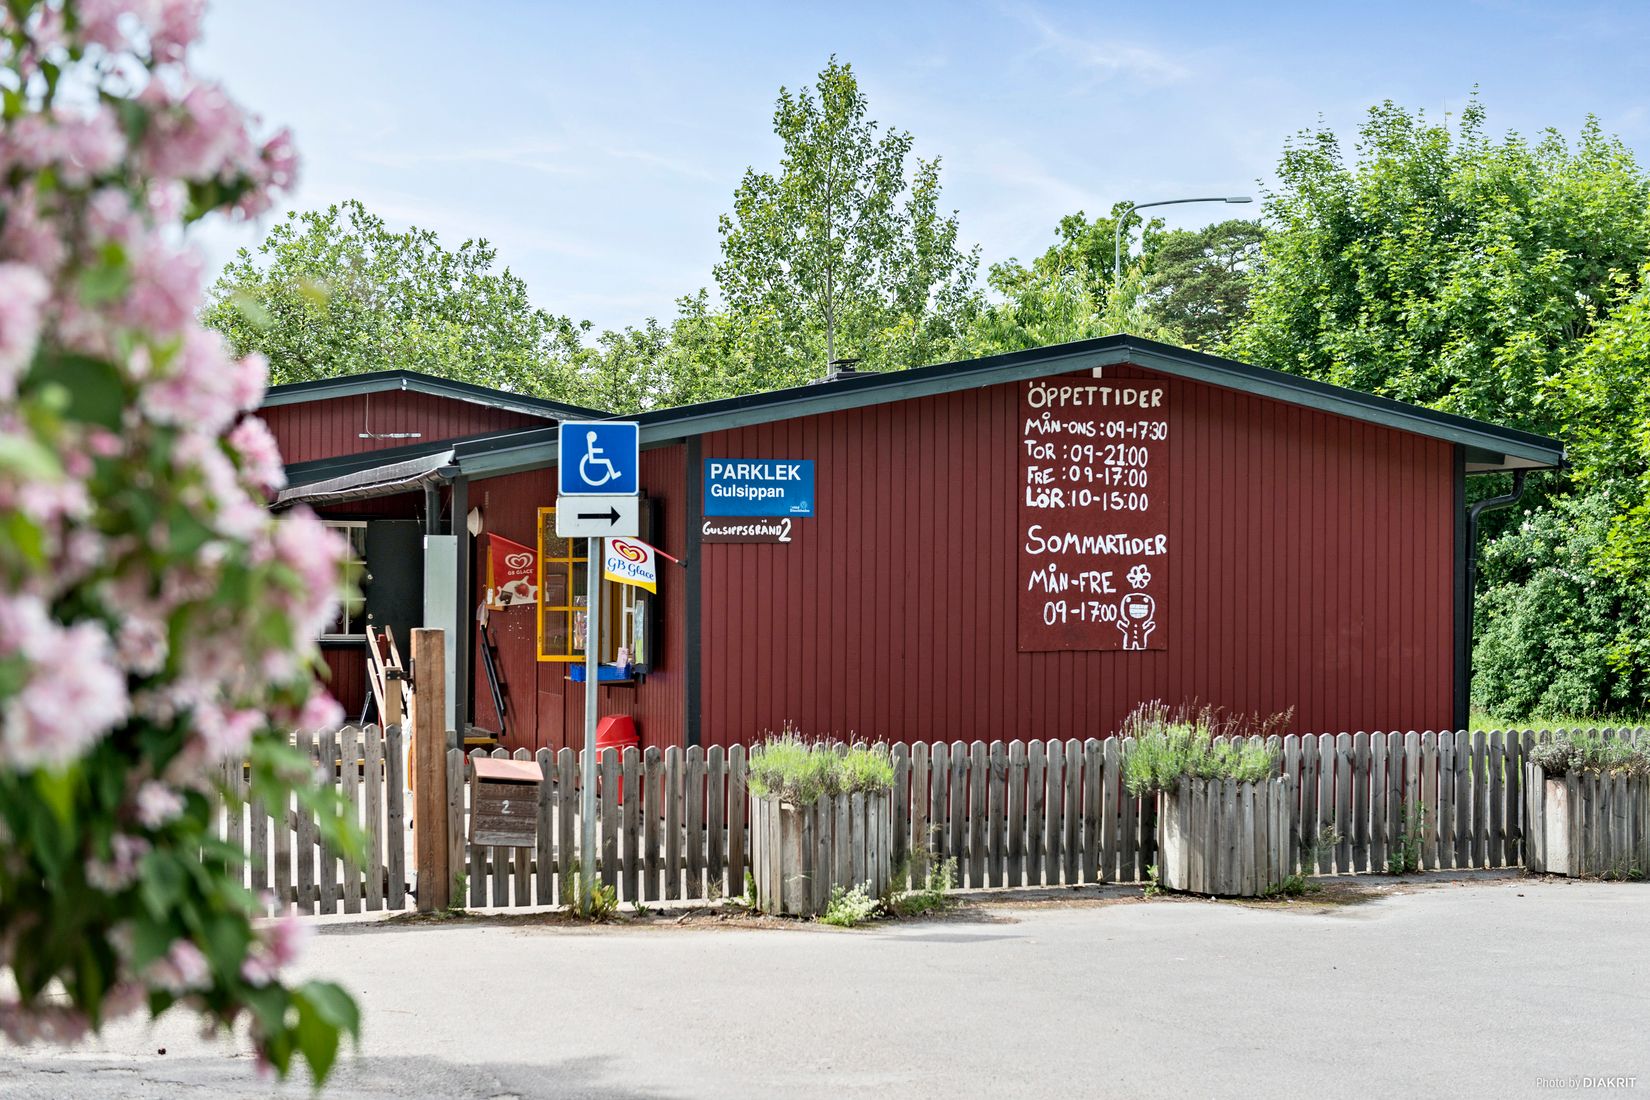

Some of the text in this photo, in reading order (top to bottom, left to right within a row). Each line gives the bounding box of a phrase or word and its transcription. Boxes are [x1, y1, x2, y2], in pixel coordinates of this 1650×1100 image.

[1028, 381, 1164, 408] ÖPPETTIDER
[1024, 440, 1056, 460] TOR
[710, 463, 801, 481] PARKLEK
[1027, 466, 1056, 485] FRE
[710, 483, 785, 501] Gulsippan
[1025, 486, 1066, 509] LÖR
[702, 518, 792, 542] GULSIPPSGRÄND 2
[1025, 524, 1167, 556] SOMMARTIDER
[607, 557, 654, 580] GB Glace
[1028, 563, 1117, 594] MÅN-FRE
[501, 799, 511, 814] 2
